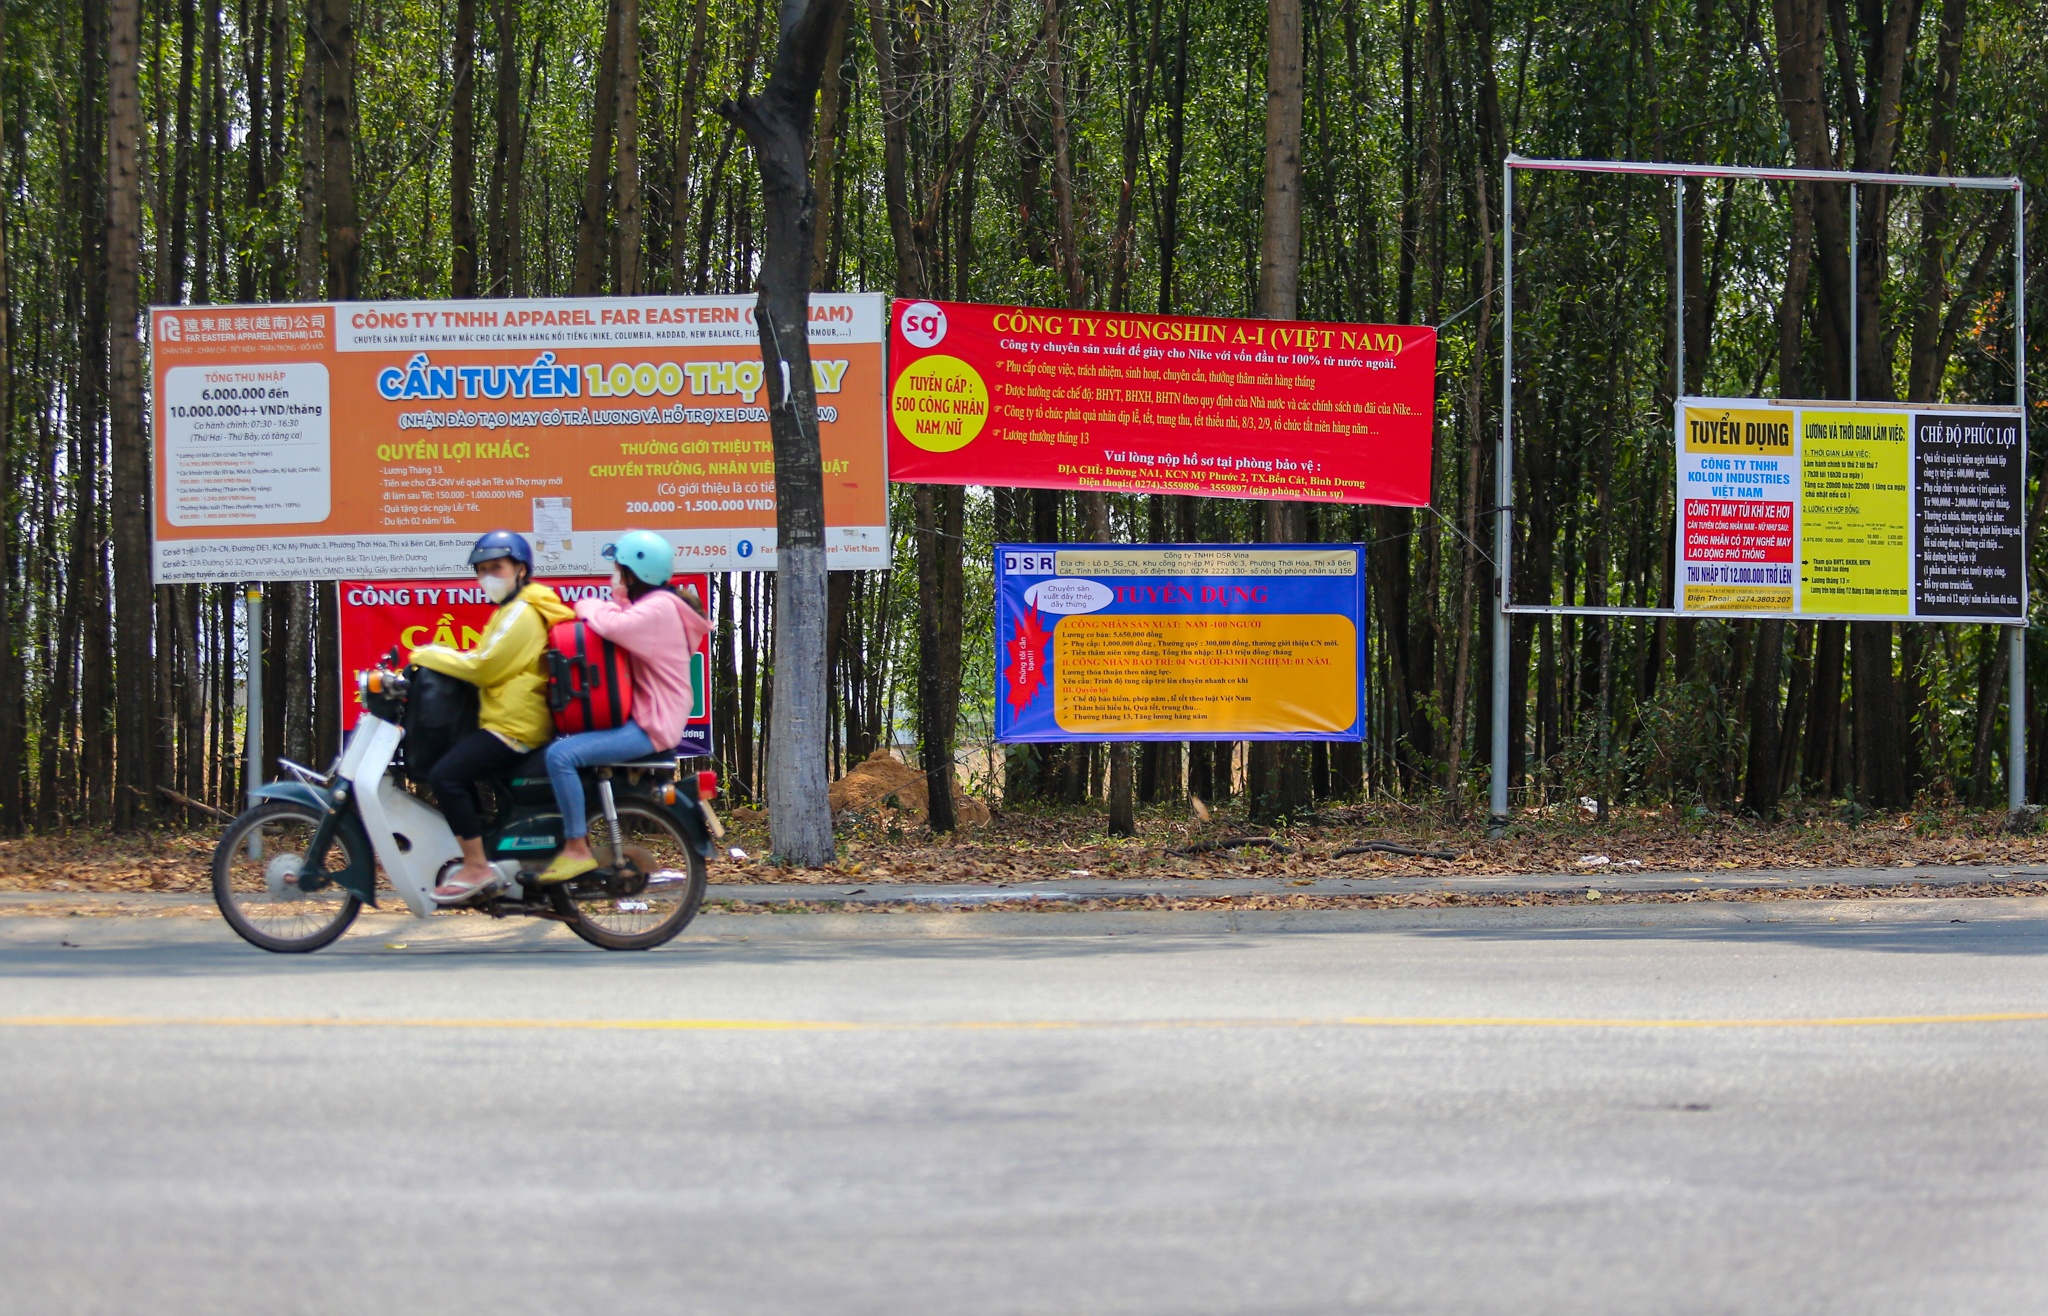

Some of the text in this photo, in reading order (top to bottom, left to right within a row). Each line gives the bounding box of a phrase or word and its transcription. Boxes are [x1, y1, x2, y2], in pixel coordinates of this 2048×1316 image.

[352, 307, 738, 329] CÔNG TY TNHH APPAREL FAR EASTERN
[201, 333, 236, 341] EASTERN
[614, 331, 653, 339] COLUMBIA,
[656, 330, 687, 339] HADDAD,
[690, 330, 706, 338] NEW
[708, 329, 742, 338] BALANCE,
[993, 309, 1402, 356] CÔNG TY SUNGSHIN A-I (VIỆT NAM)
[1000, 339, 1028, 352] Công
[1030, 342, 1040, 353] ty
[1043, 341, 1080, 355] chuyên
[1082, 343, 1100, 354] sản
[1103, 342, 1125, 355] xuất
[1143, 346, 1164, 360] giày
[1167, 348, 1186, 358] cho
[1188, 349, 1212, 360] Nike
[1215, 350, 1231, 360] với
[1234, 348, 1252, 361] vốn
[1255, 349, 1274, 362] đầu
[1292, 354, 1320, 365] 100%
[1323, 355, 1336, 365] từ
[1337, 356, 1362, 367] nước
[1366, 357, 1396, 371] ngoài.
[234, 373, 255, 381] THU
[378, 352, 456, 400] CẦN
[459, 352, 581, 399] TUYỂN
[584, 362, 684, 397] 1.000
[685, 361, 764, 403] THỢ
[909, 371, 942, 392] TUYỂN
[945, 374, 967, 393] GẤP
[202, 387, 288, 400] 6.000.000 đến
[896, 395, 984, 415] 500 CÔNG NHÂN
[511, 412, 539, 426] MAY
[542, 409, 562, 425] CÓ
[594, 410, 640, 424] LƯƠNG
[641, 408, 661, 424] VÀ
[716, 409, 736, 422] XE
[916, 418, 962, 435] NAM/NỮ
[1690, 411, 1788, 451] TUYỂN DỤNG
[1828, 422, 1837, 439] VÀ
[1855, 425, 1871, 440] GIAN
[1873, 423, 1886, 440] LÀM
[1920, 421, 2016, 449] CHẾ ĐỘ PHÚC LỢI
[1003, 429, 1028, 444] Lương
[1057, 431, 1077, 446] tháng
[1081, 432, 1088, 444] 13
[377, 438, 529, 462] QUYỀN LỢI KHÁC:
[1701, 457, 1777, 471] CÔNG TY TNHH
[1688, 471, 1789, 484] KOLON INDUSTRIES
[1712, 484, 1762, 498] VIỆT NAM
[626, 501, 674, 512] 200.000
[685, 500, 744, 511] 1.500.000
[1688, 501, 1709, 516] CÔNG
[1711, 504, 1720, 516] TY
[1721, 505, 1737, 517] MAY
[1765, 506, 1775, 518] XE
[1164, 552, 1182, 560] Công
[1688, 548, 1702, 558] LAO
[1687, 566, 1699, 581] THU
[1720, 564, 1729, 582] TỪ
[1730, 567, 1764, 583] 12.000.000
[348, 586, 410, 606] CÔNG
[414, 588, 441, 604] TY
[1201, 586, 1268, 606] DỤNG
[1736, 595, 1791, 603] 0274.3803.207
